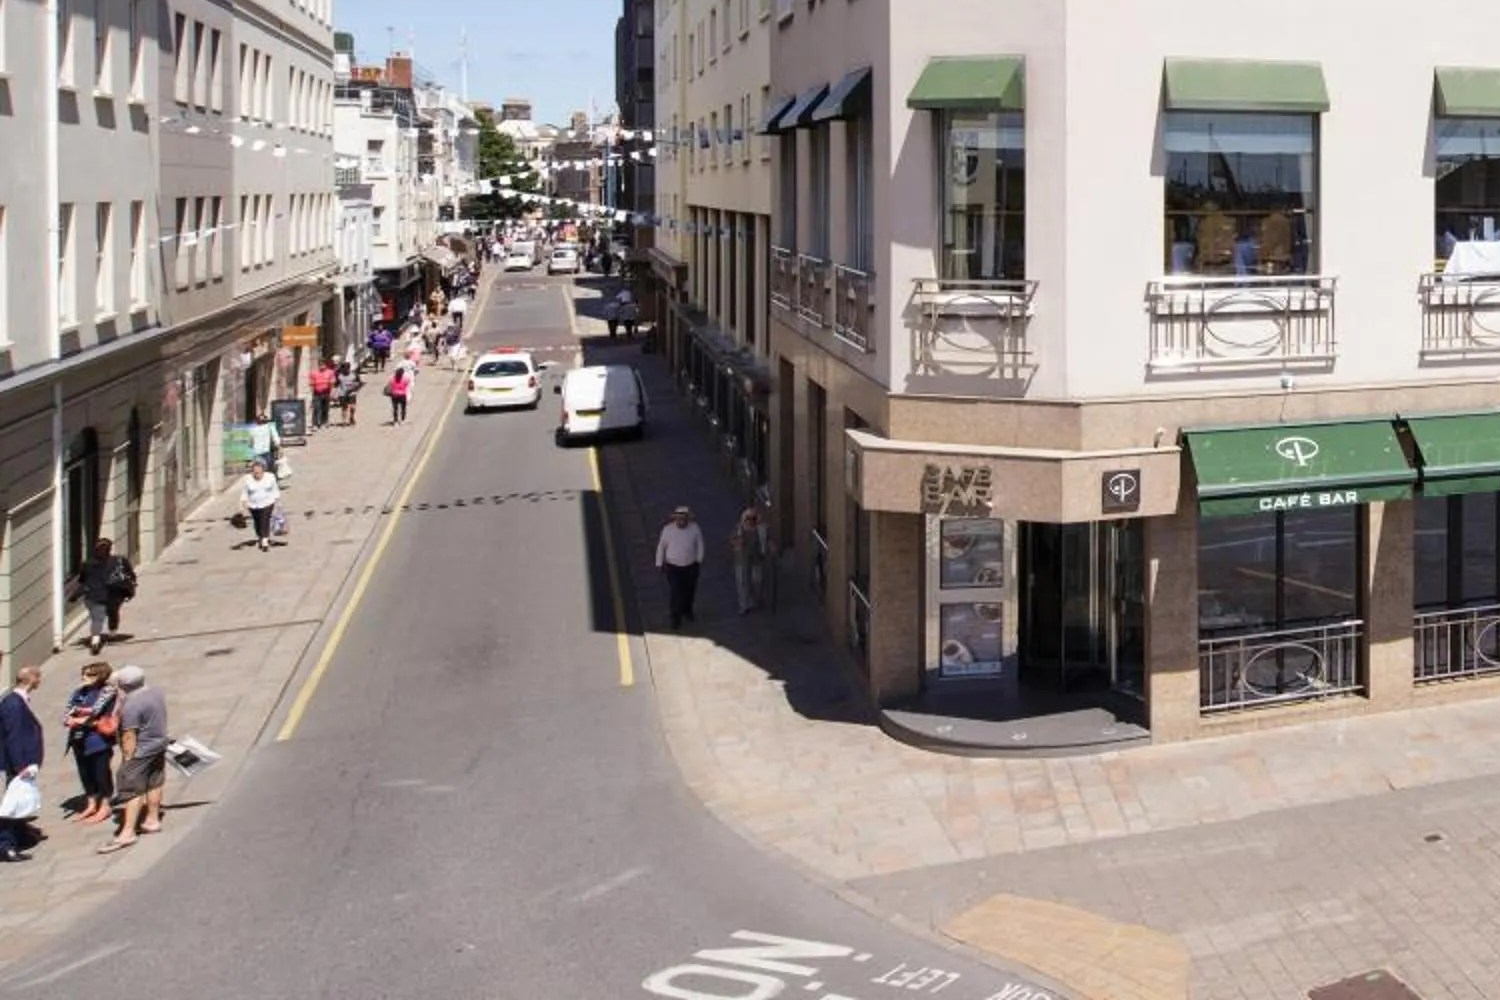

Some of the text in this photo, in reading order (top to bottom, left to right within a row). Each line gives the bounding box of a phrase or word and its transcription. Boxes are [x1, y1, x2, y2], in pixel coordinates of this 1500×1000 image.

[1259, 491, 1358, 511] CAFÉ BAR
[870, 963, 961, 993] LEFT
